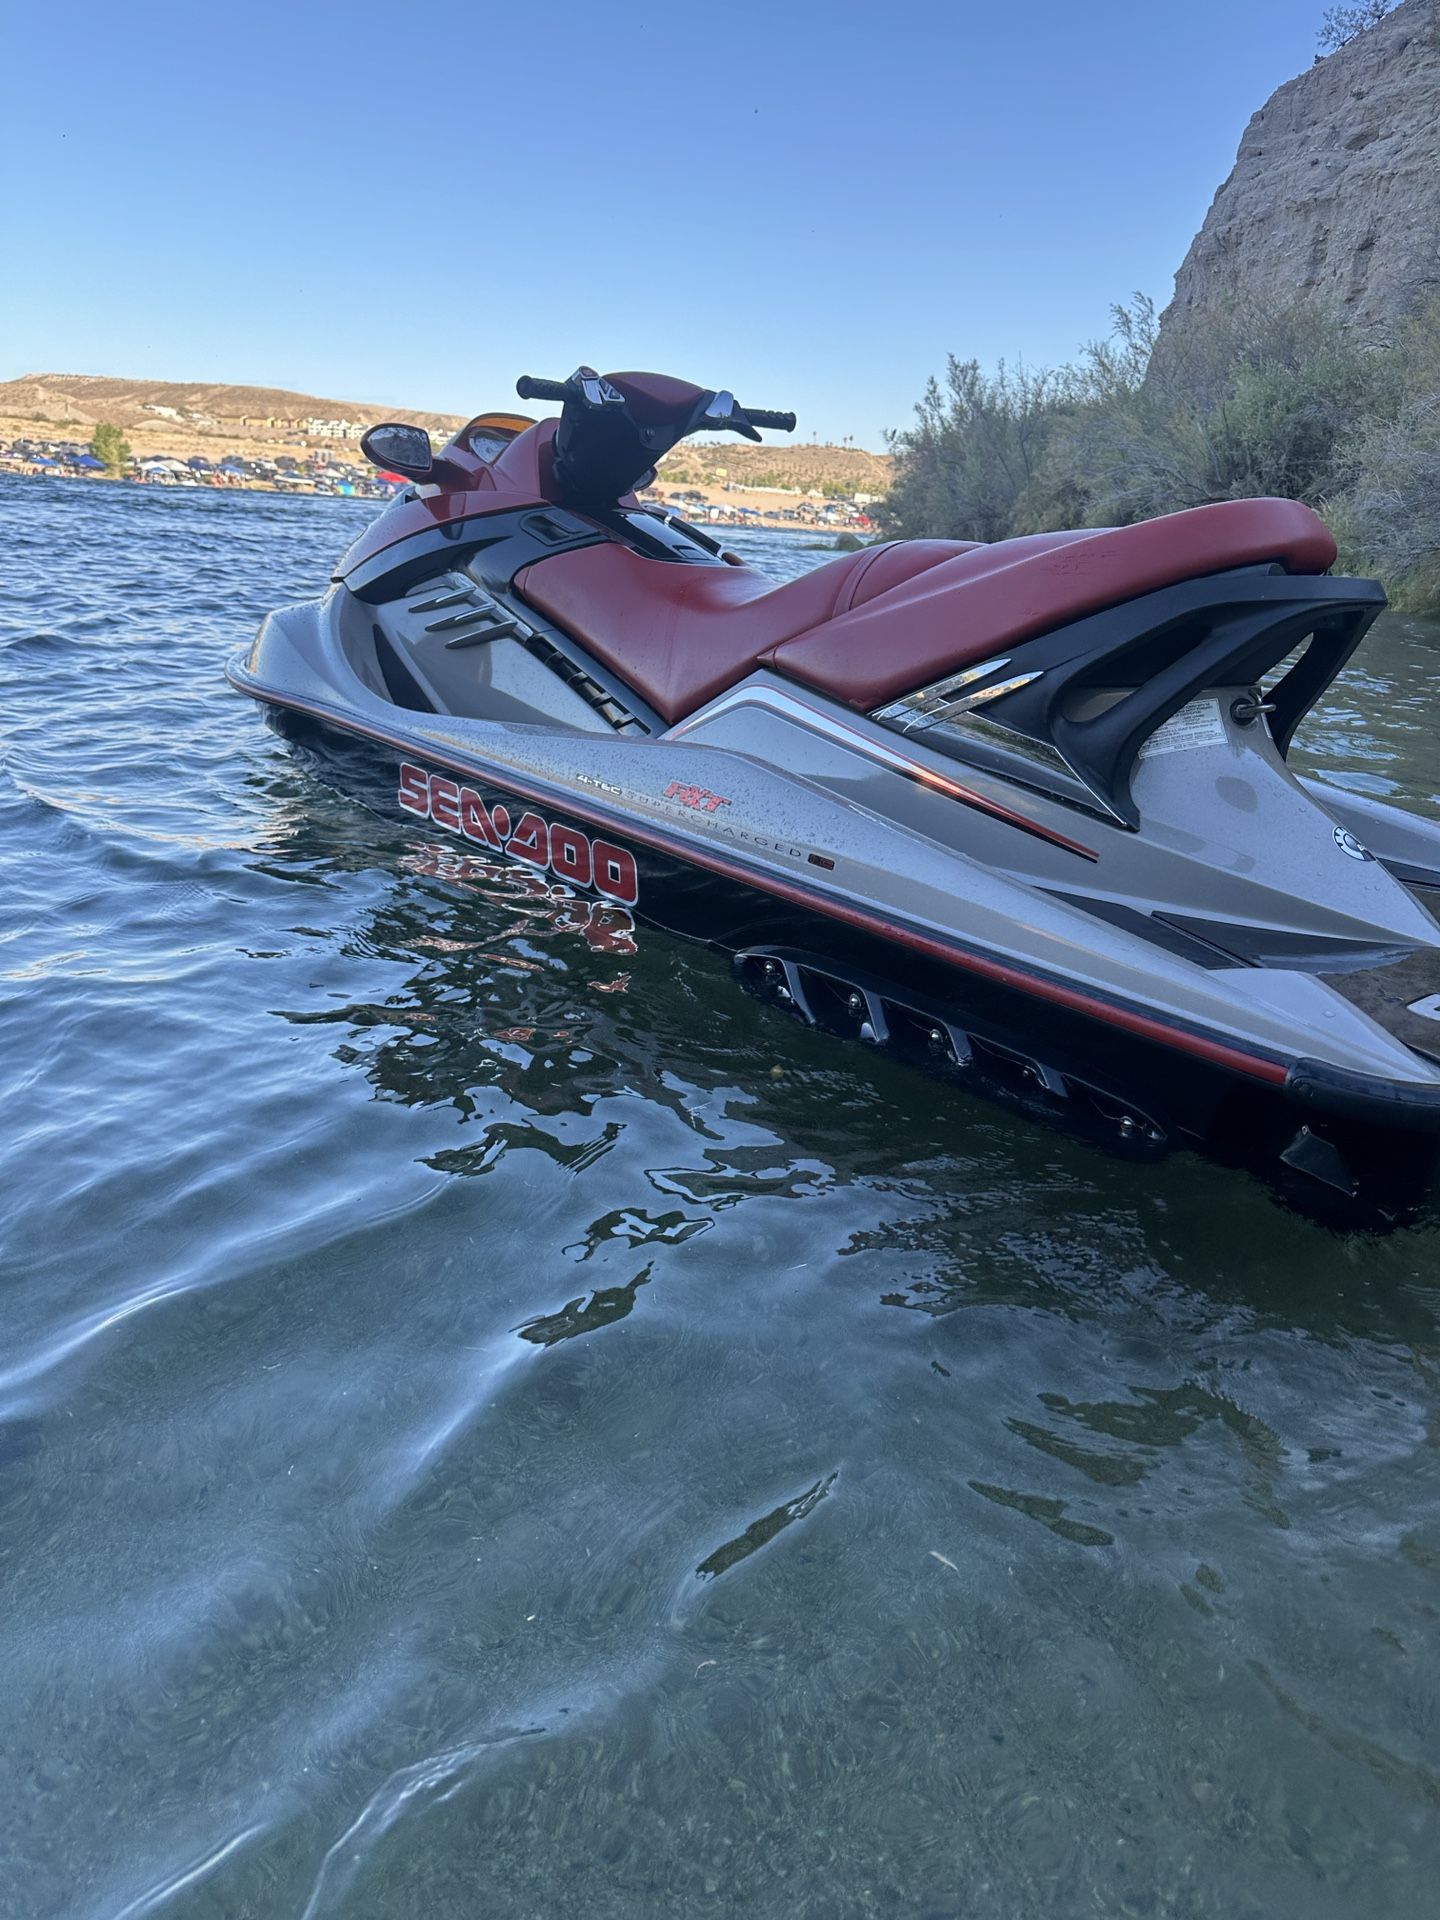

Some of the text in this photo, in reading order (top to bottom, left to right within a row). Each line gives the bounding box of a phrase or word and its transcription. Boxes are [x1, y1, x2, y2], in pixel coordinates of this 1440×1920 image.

[576, 773, 802, 858] 4-TEC SUPERCHARGED
[663, 780, 733, 814] RXT
